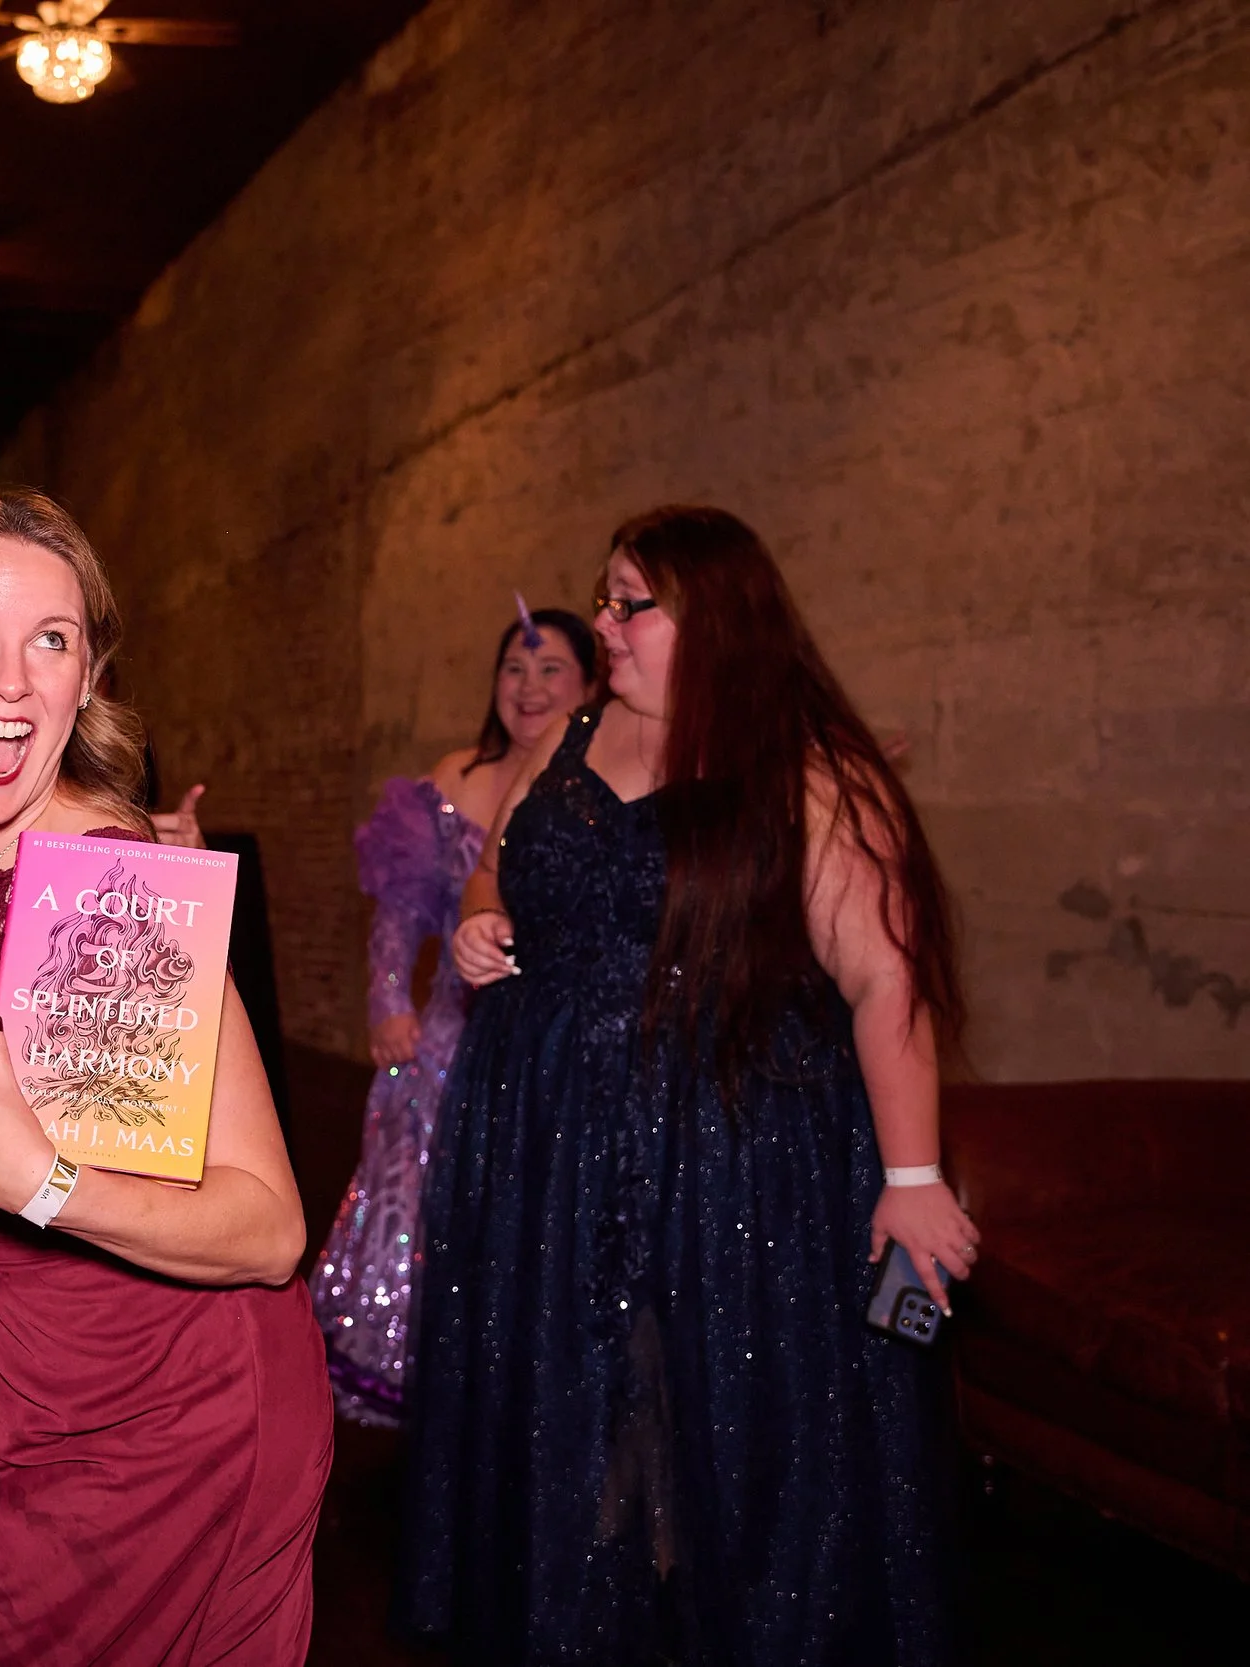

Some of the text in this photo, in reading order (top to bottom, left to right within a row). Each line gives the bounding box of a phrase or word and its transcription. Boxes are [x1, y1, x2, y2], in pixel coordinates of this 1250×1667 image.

[46, 840, 111, 855] BESTSELLING
[114, 848, 153, 860] GLOBAL
[157, 852, 227, 868] PHENOMENON
[31, 883, 204, 928] A COURT
[95, 947, 136, 971] OF
[10, 987, 199, 1032] SPLINTERED
[27, 1043, 200, 1086] HARMONY
[30, 1087, 81, 1101] VALKYRIE
[122, 1099, 178, 1113] MOVEMENT
[89, 1124, 105, 1148] J.
[114, 1127, 195, 1158] MAAS
[40, 1188, 51, 1200] VIP
